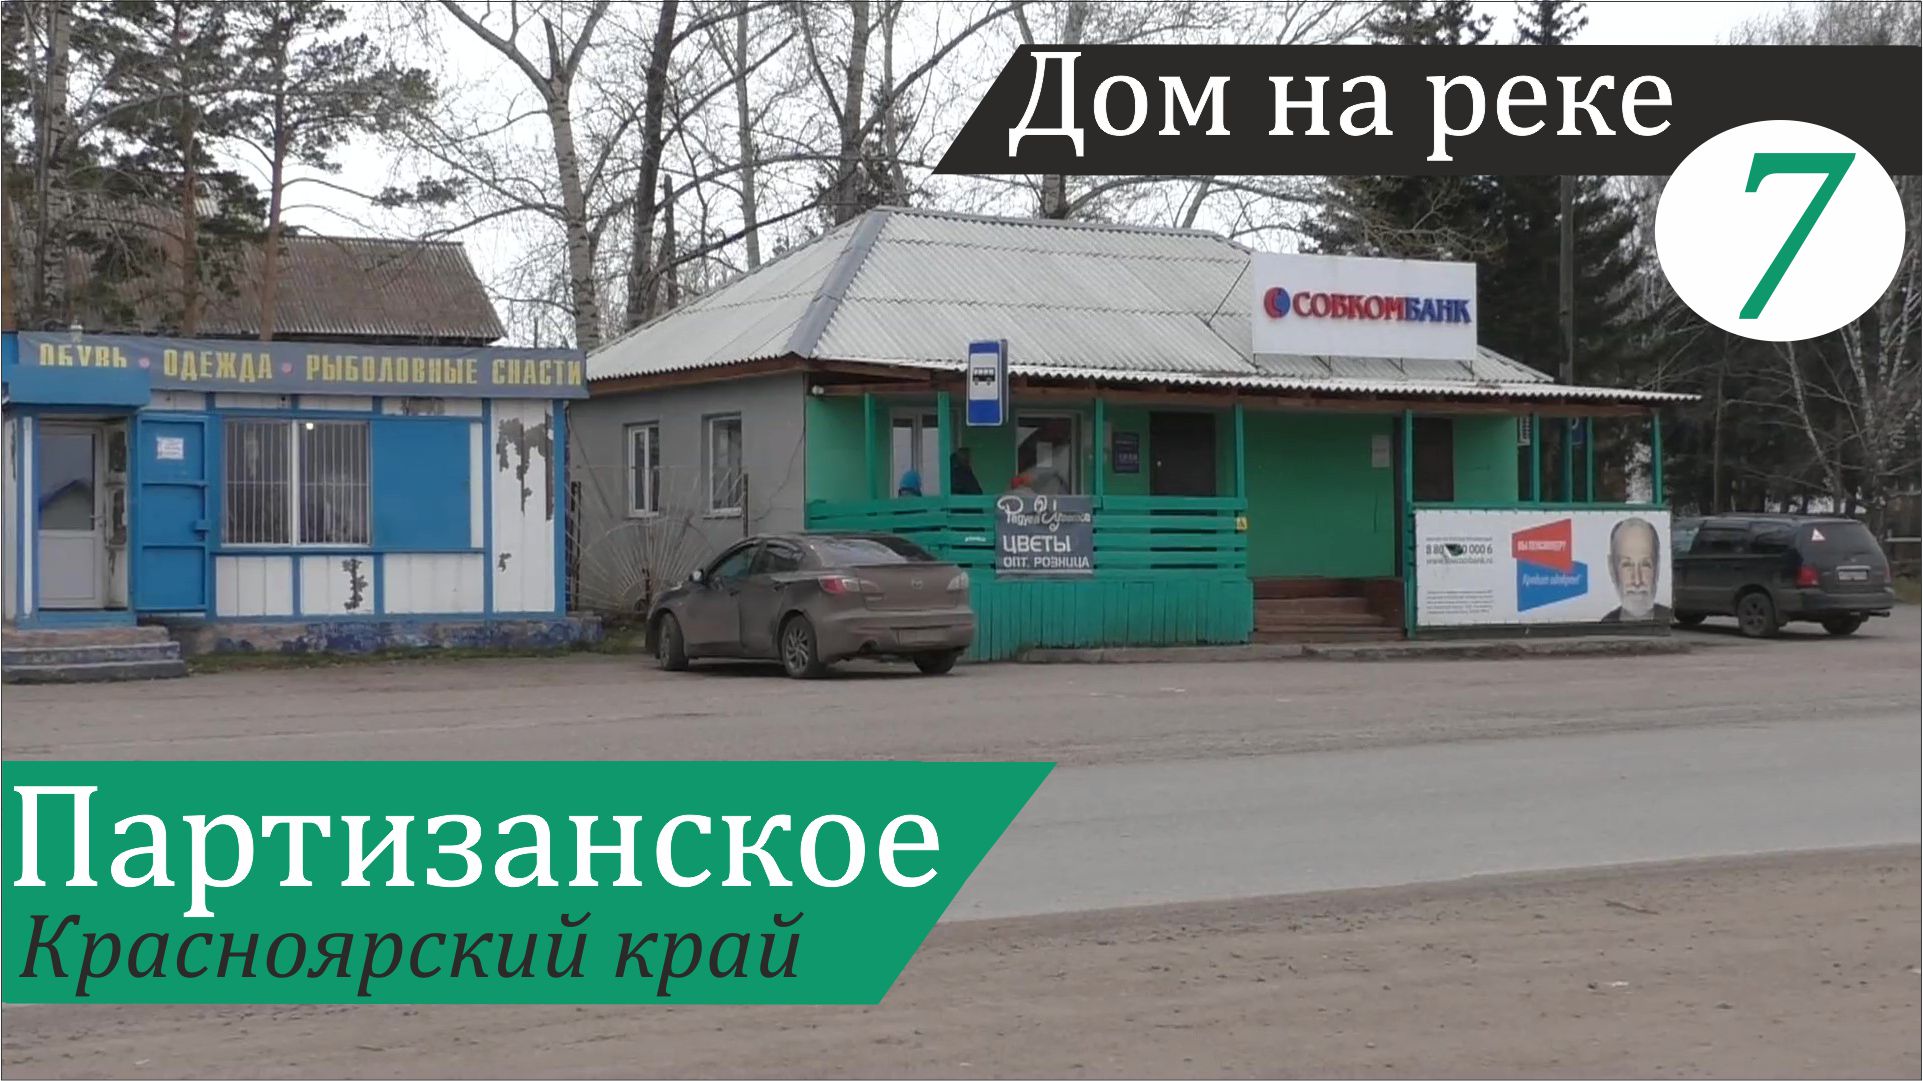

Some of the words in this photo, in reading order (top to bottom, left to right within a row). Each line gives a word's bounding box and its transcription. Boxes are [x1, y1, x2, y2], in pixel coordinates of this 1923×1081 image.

[1293, 291, 1472, 324] СОВКОМБАНК
[163, 349, 273, 383] ОДЕЖДА
[305, 354, 478, 385] РЫБОЛОВНЫЕ
[491, 358, 582, 386] СНАСТИ
[1002, 534, 1072, 554] ЦВЕТЫ
[1034, 556, 1090, 568] РОЗНИЦА
